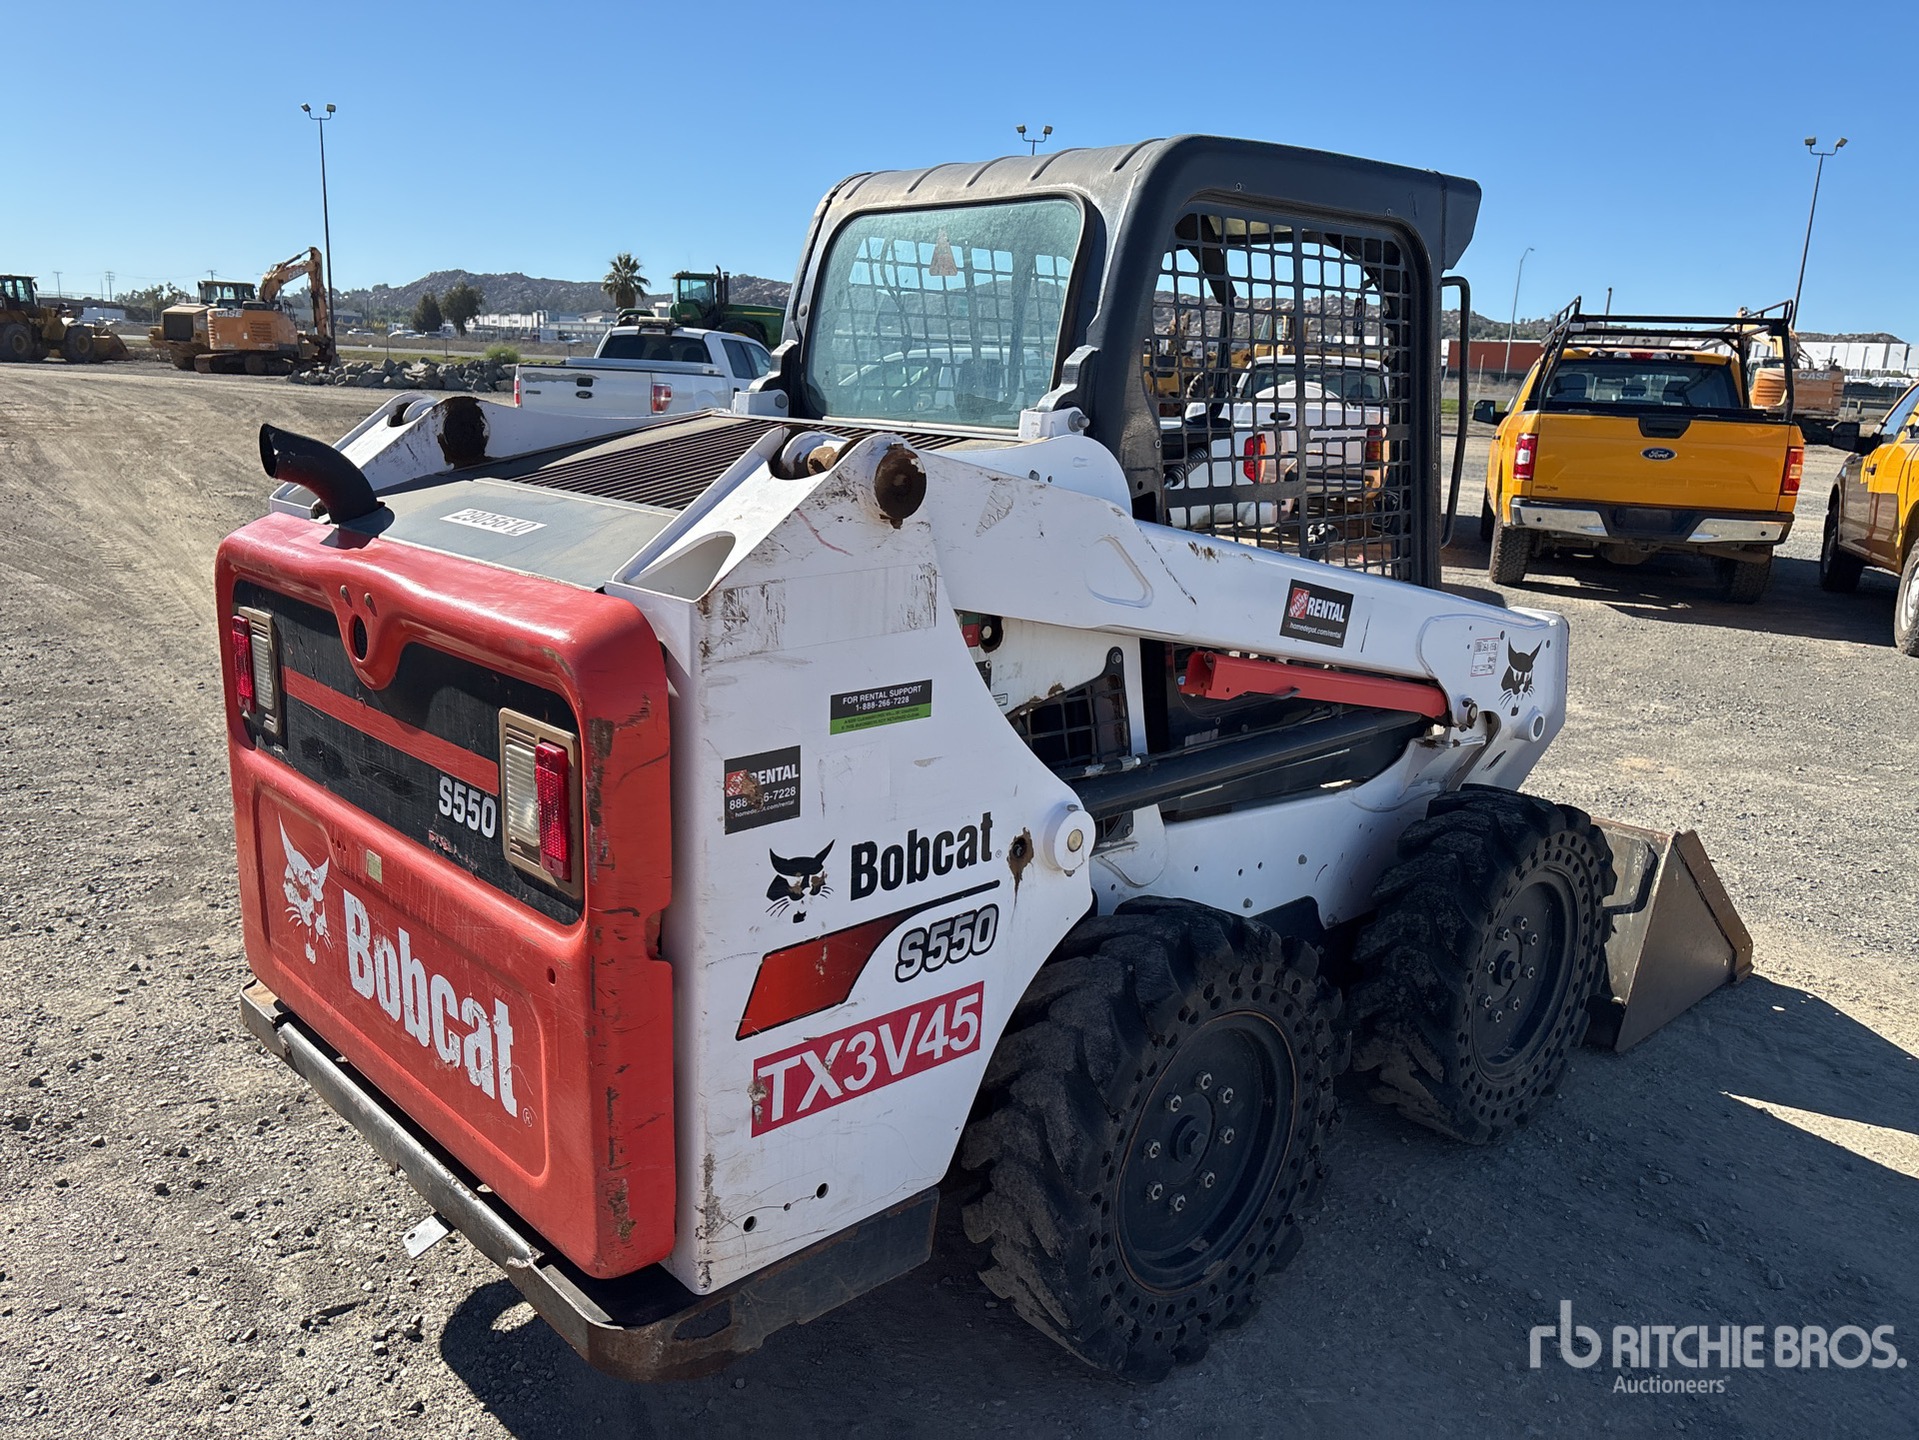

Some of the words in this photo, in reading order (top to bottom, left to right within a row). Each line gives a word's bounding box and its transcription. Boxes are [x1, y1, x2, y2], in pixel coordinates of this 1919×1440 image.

[216, 310, 243, 318] CASE
[1798, 371, 1831, 380] CASE
[451, 510, 538, 535] 2905610
[1306, 596, 1345, 623] RENTAL
[842, 696, 859, 705] FOR
[860, 691, 888, 702] RENTAL
[889, 685, 922, 697] SUPPORT
[855, 695, 909, 711] 1-888-266-7228
[439, 776, 496, 838] S550
[850, 812, 993, 901] Bobcat
[895, 903, 1000, 983] S550
[343, 889, 517, 1118] Bobcat
[757, 992, 980, 1122] TX3V45
